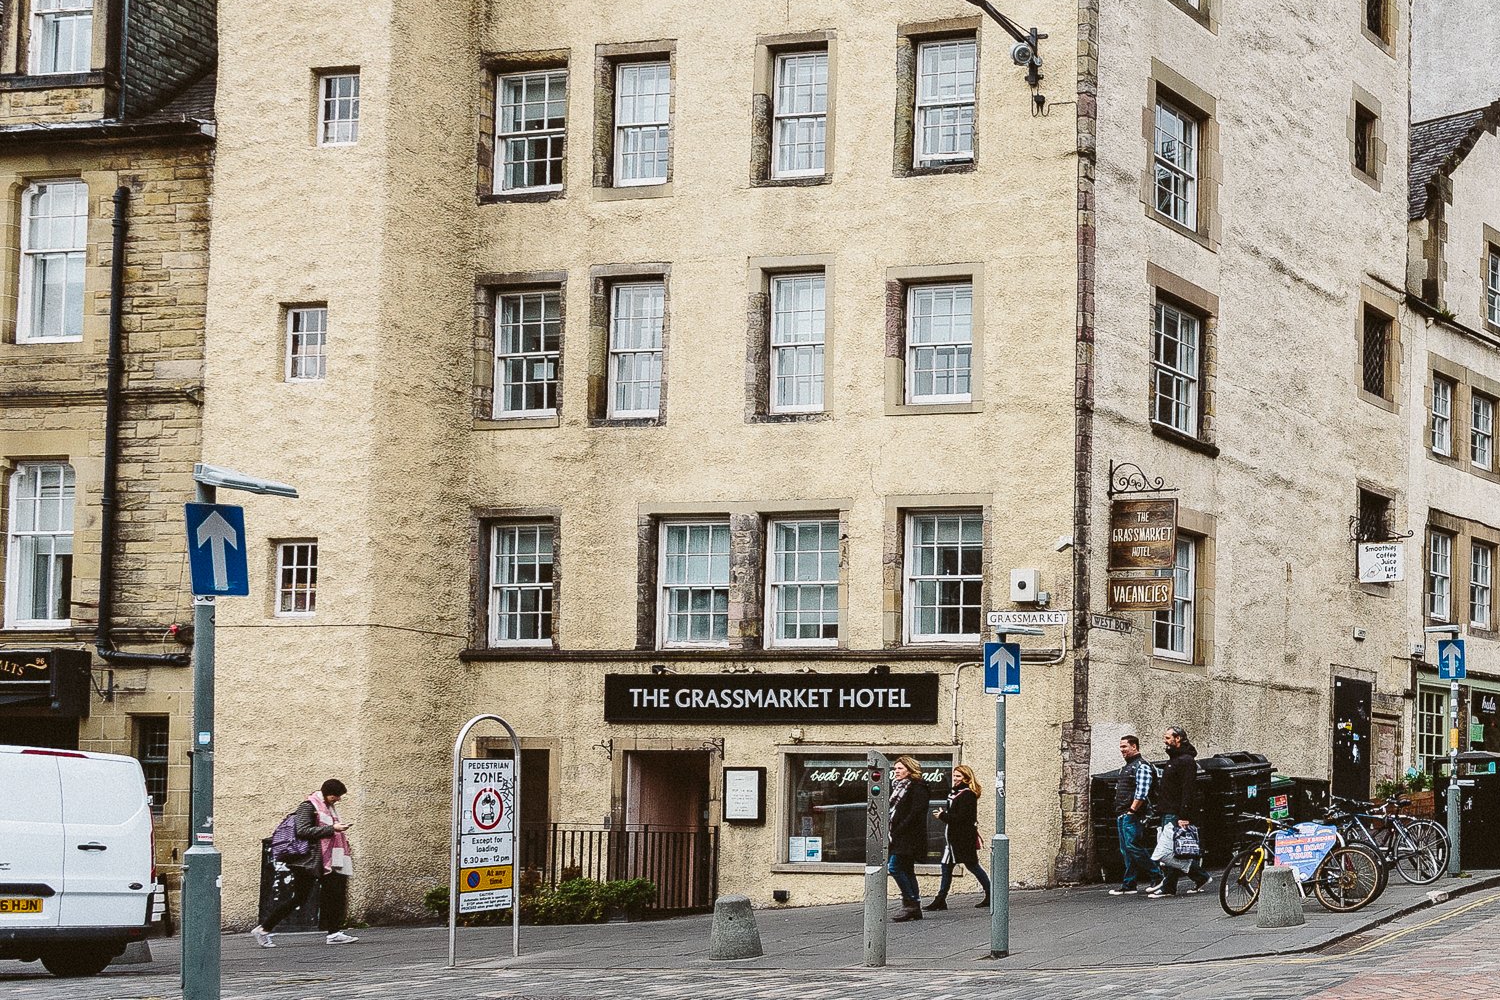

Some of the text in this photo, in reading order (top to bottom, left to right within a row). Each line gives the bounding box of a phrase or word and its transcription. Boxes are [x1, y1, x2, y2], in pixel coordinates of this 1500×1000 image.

[1137, 511, 1150, 522] THE
[1112, 527, 1172, 542] GRASSMARKET
[1132, 546, 1151, 557] HOTEL
[1114, 585, 1168, 602] VACANCIES
[990, 614, 1066, 624] GRASSMARKET
[1094, 616, 1131, 632] WEST BOW
[629, 688, 912, 708] THE GRASSMARKET HOTEL
[474, 772, 503, 783] ZONE
[476, 845, 498, 853] loading
[12, 900, 38, 910] HJN
